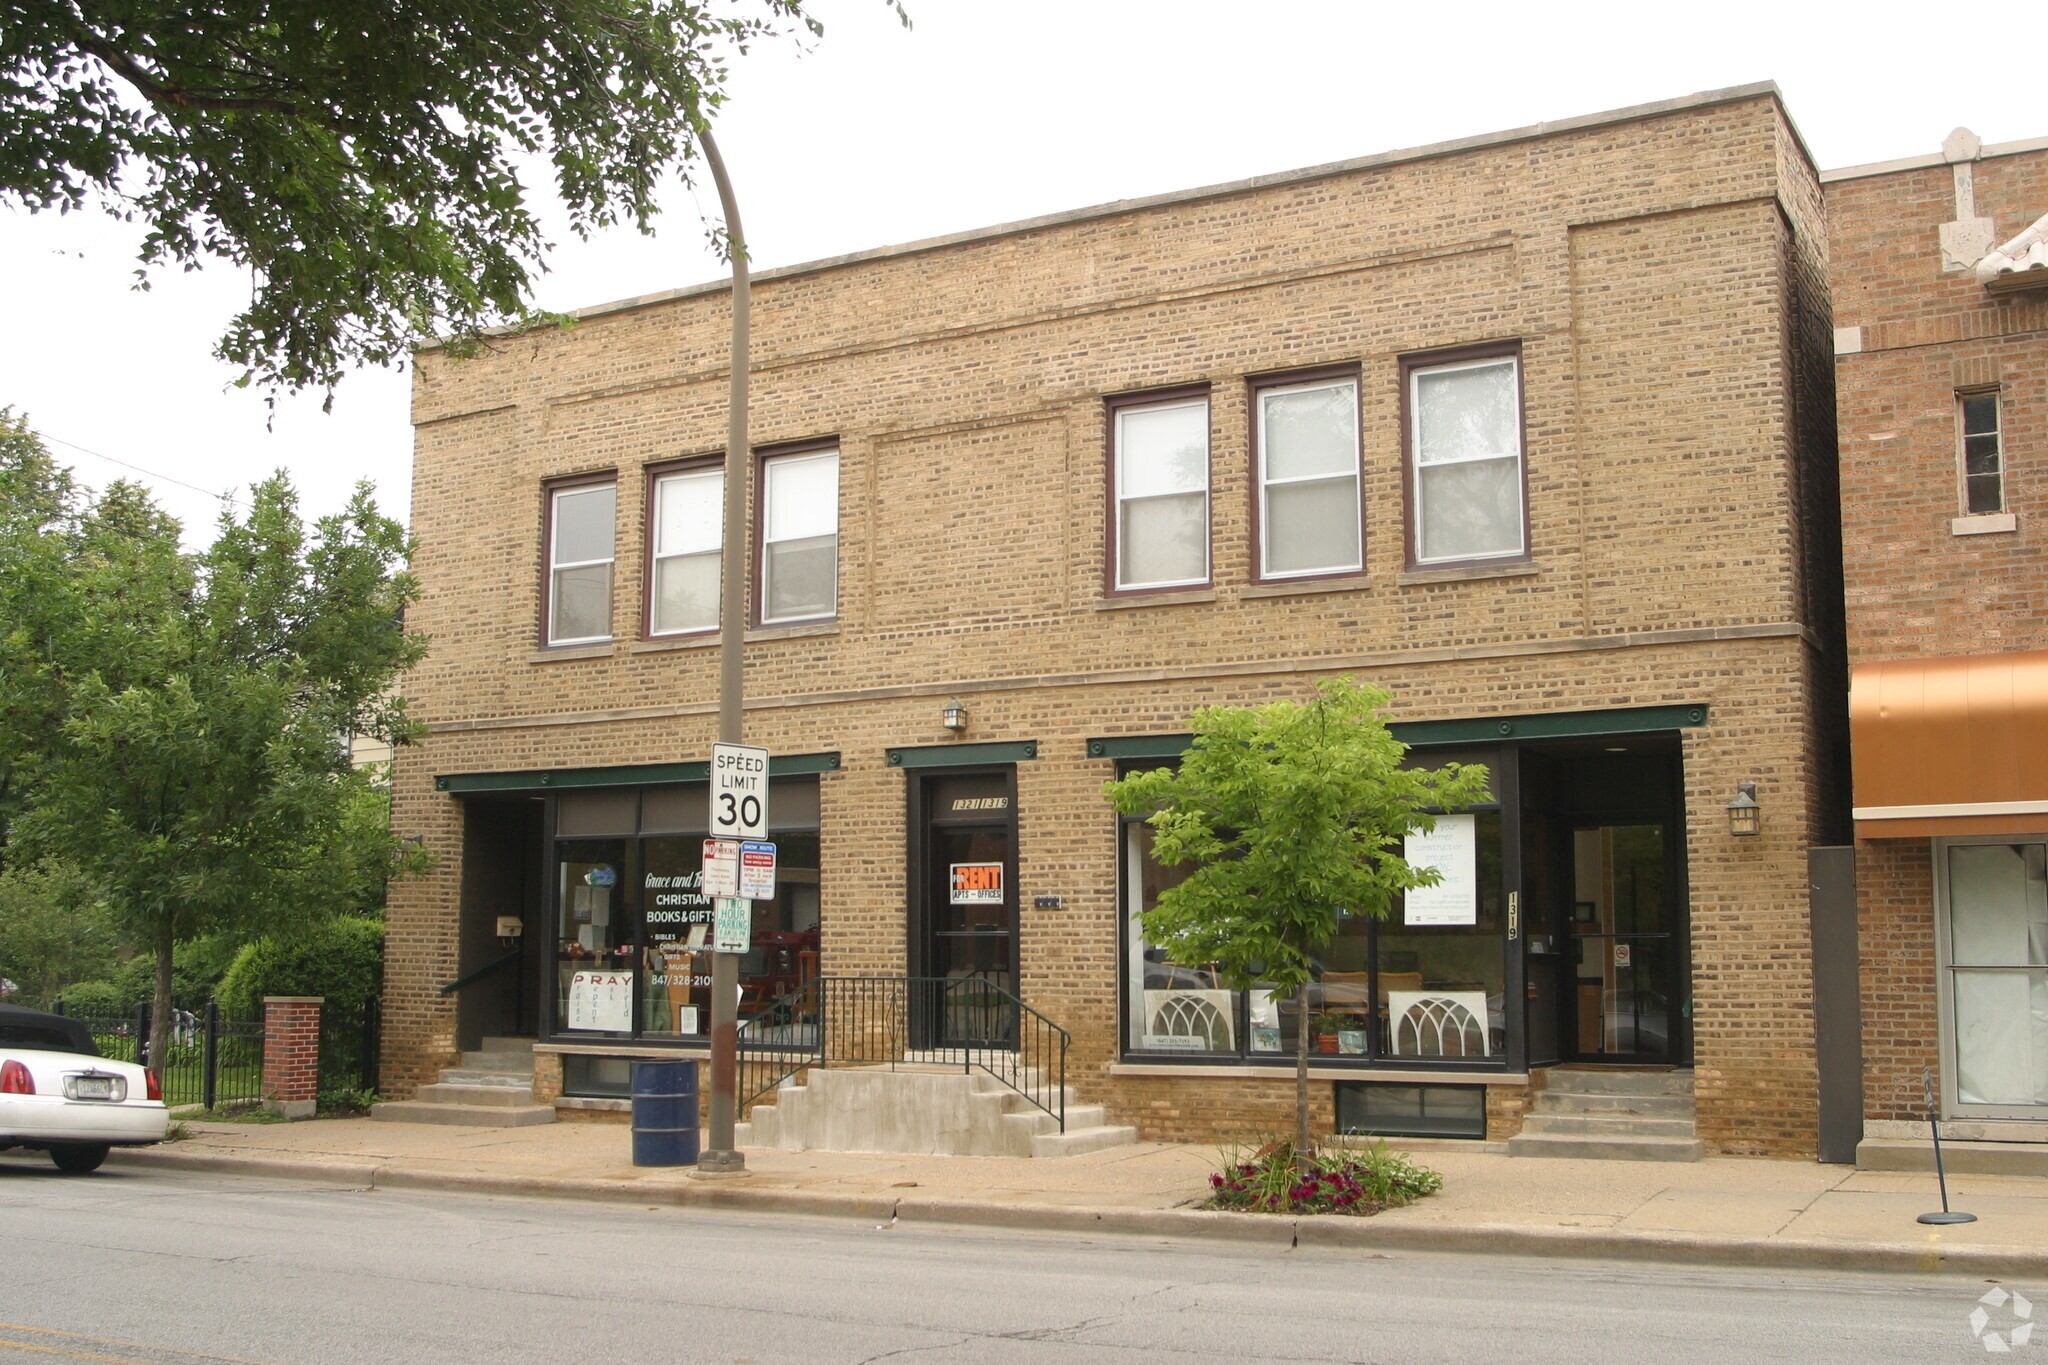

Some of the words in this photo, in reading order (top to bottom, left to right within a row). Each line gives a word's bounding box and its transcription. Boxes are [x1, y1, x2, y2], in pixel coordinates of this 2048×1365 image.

[717, 754, 764, 773] SPEED
[721, 774, 758, 791] LIMIT
[718, 792, 761, 828] 30
[1440, 823, 1457, 831] your
[705, 844, 714, 855] NO
[714, 847, 736, 856] PARKING
[1415, 844, 1463, 852] construction
[1425, 854, 1454, 862] project
[645, 873, 671, 888] Grace
[671, 871, 694, 888] and
[953, 874, 964, 883] FOR
[956, 866, 1000, 890] RENT
[656, 894, 711, 906] CHRISTIAN
[953, 890, 969, 899] APTS
[977, 889, 1001, 899] OFFICES
[724, 898, 743, 910] TWO
[721, 908, 745, 920] HOUR
[717, 918, 748, 931] PARKING
[574, 975, 632, 985] PRAY
